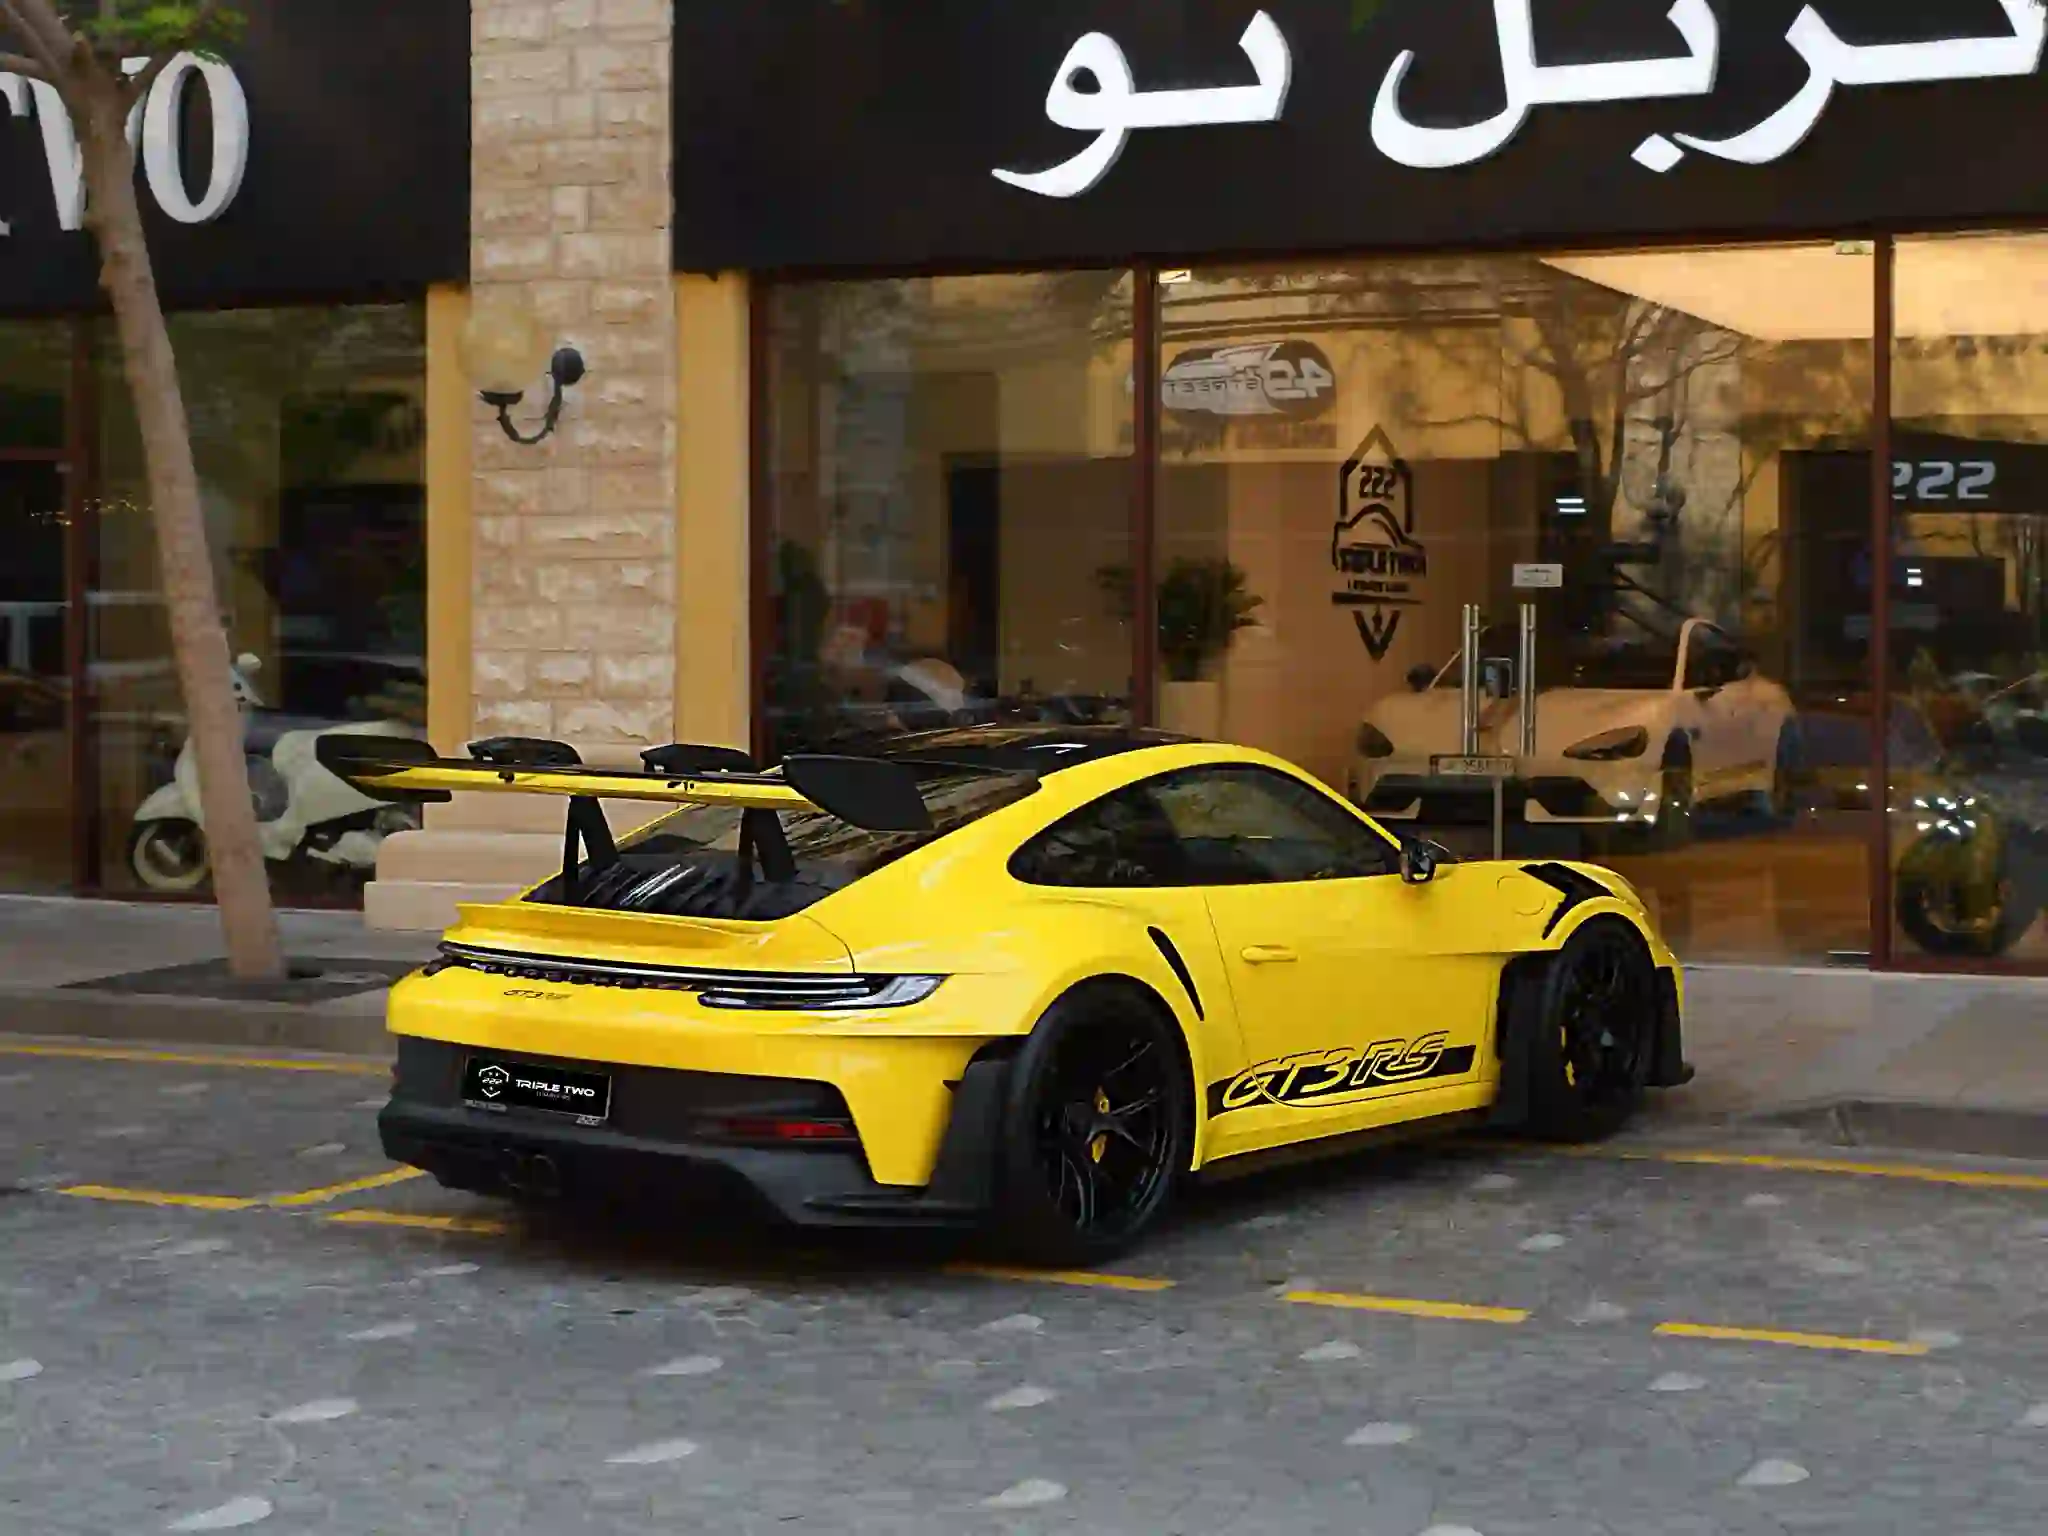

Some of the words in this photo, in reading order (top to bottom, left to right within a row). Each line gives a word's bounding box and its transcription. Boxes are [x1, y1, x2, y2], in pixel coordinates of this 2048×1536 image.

[1359, 465, 1397, 500] 222
[1222, 1047, 1355, 1109] GT3
[1350, 1030, 1450, 1086] RS
[515, 1079, 561, 1093] TRIPLE
[563, 1085, 596, 1097] TWO
